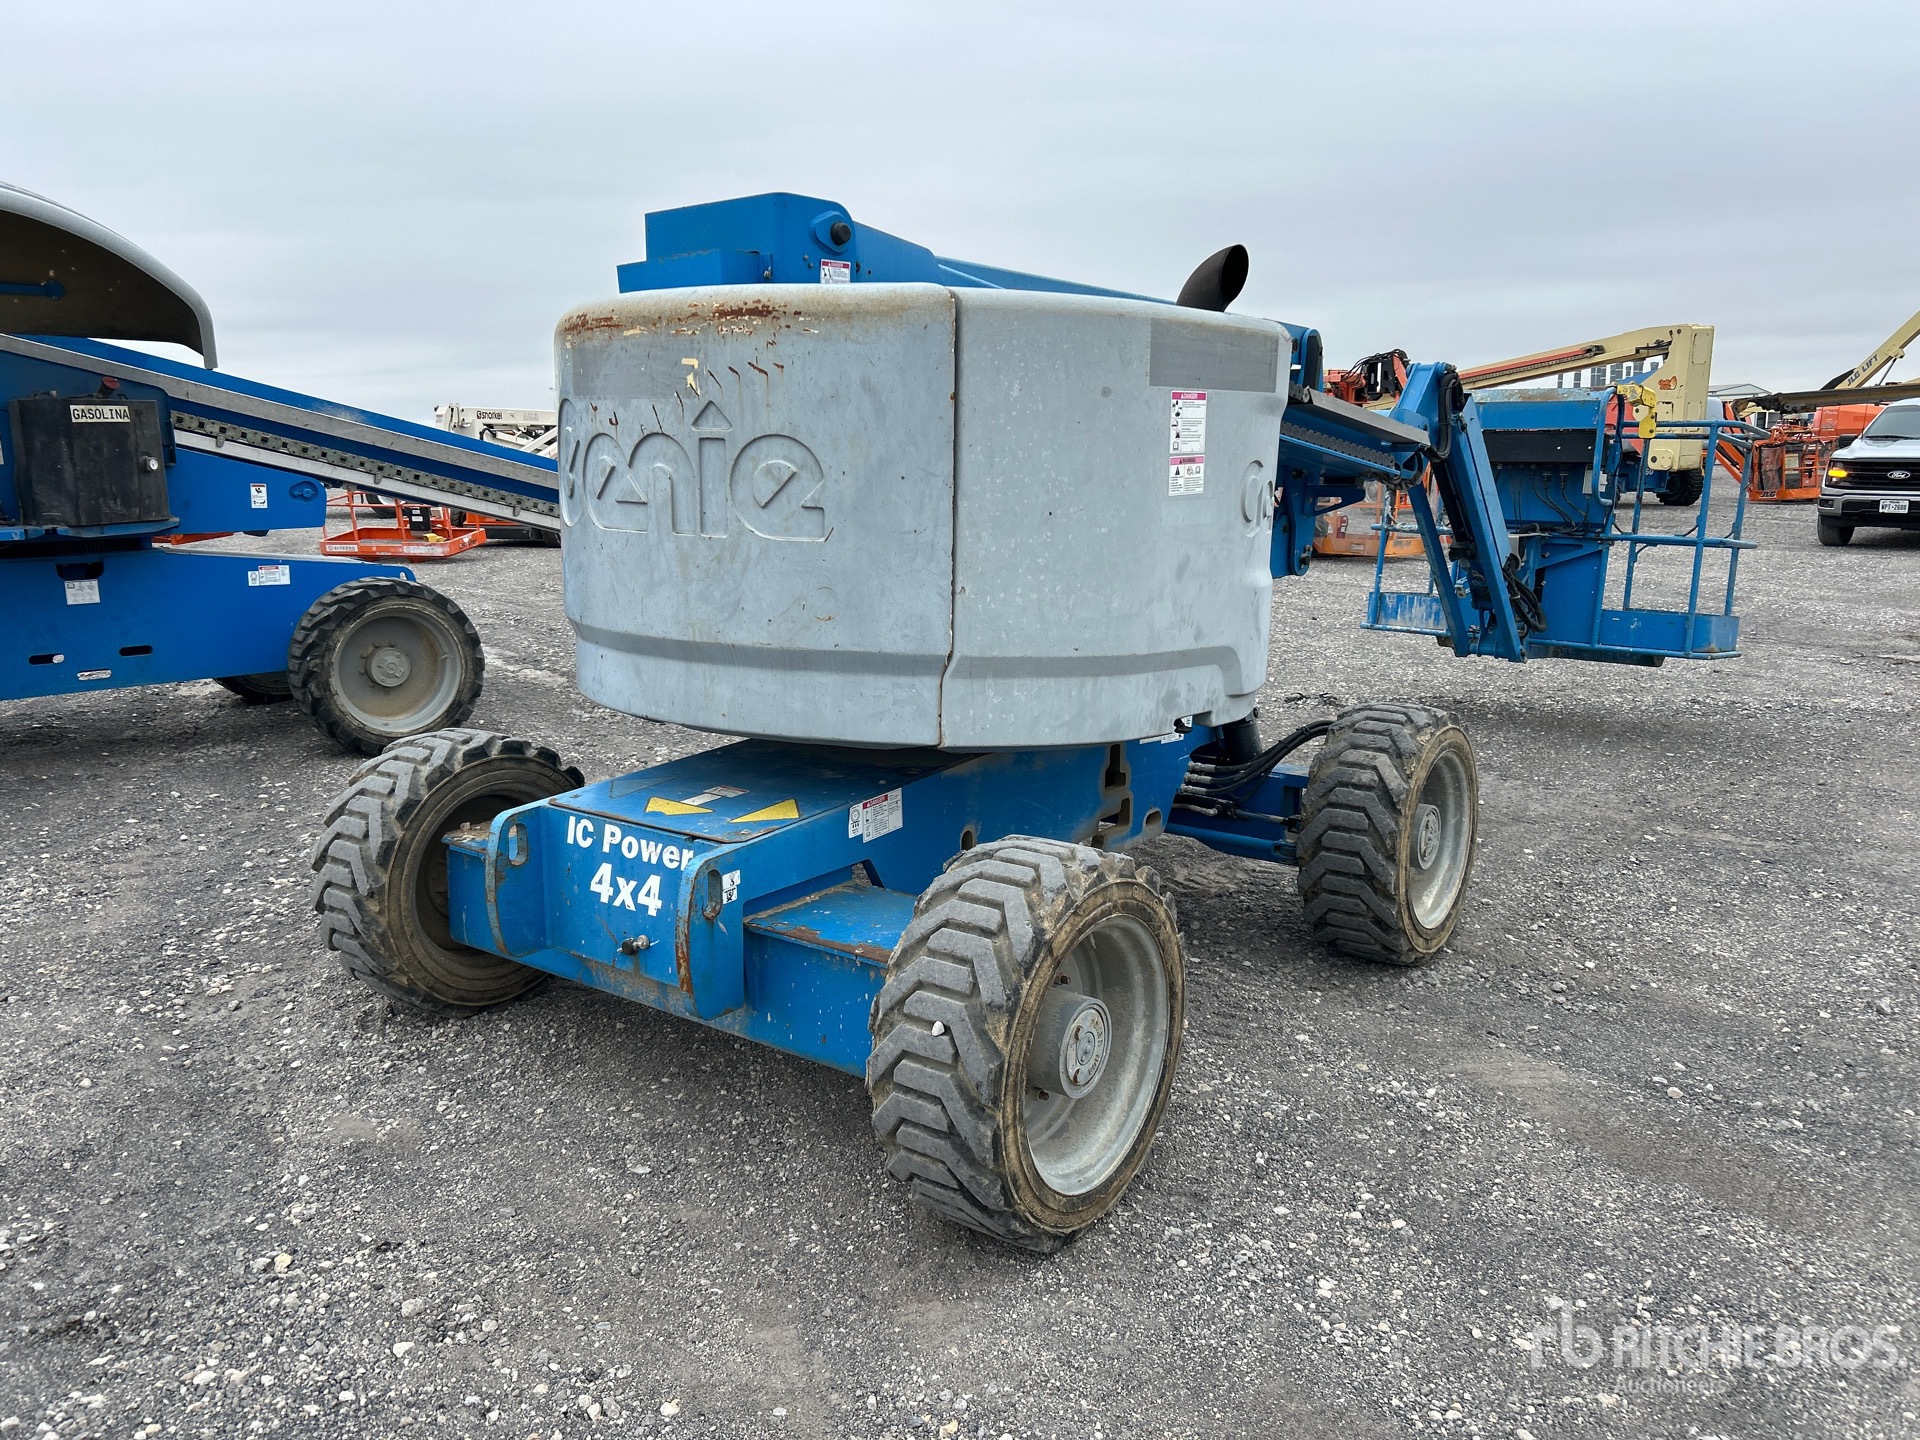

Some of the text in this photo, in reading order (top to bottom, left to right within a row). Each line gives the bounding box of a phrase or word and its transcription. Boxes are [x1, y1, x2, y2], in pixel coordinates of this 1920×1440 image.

[1847, 354, 1878, 387] JLG LIFT
[72, 408, 130, 420] GASOLINA
[567, 815, 694, 871] IC Power
[590, 862, 663, 917] 4x4
